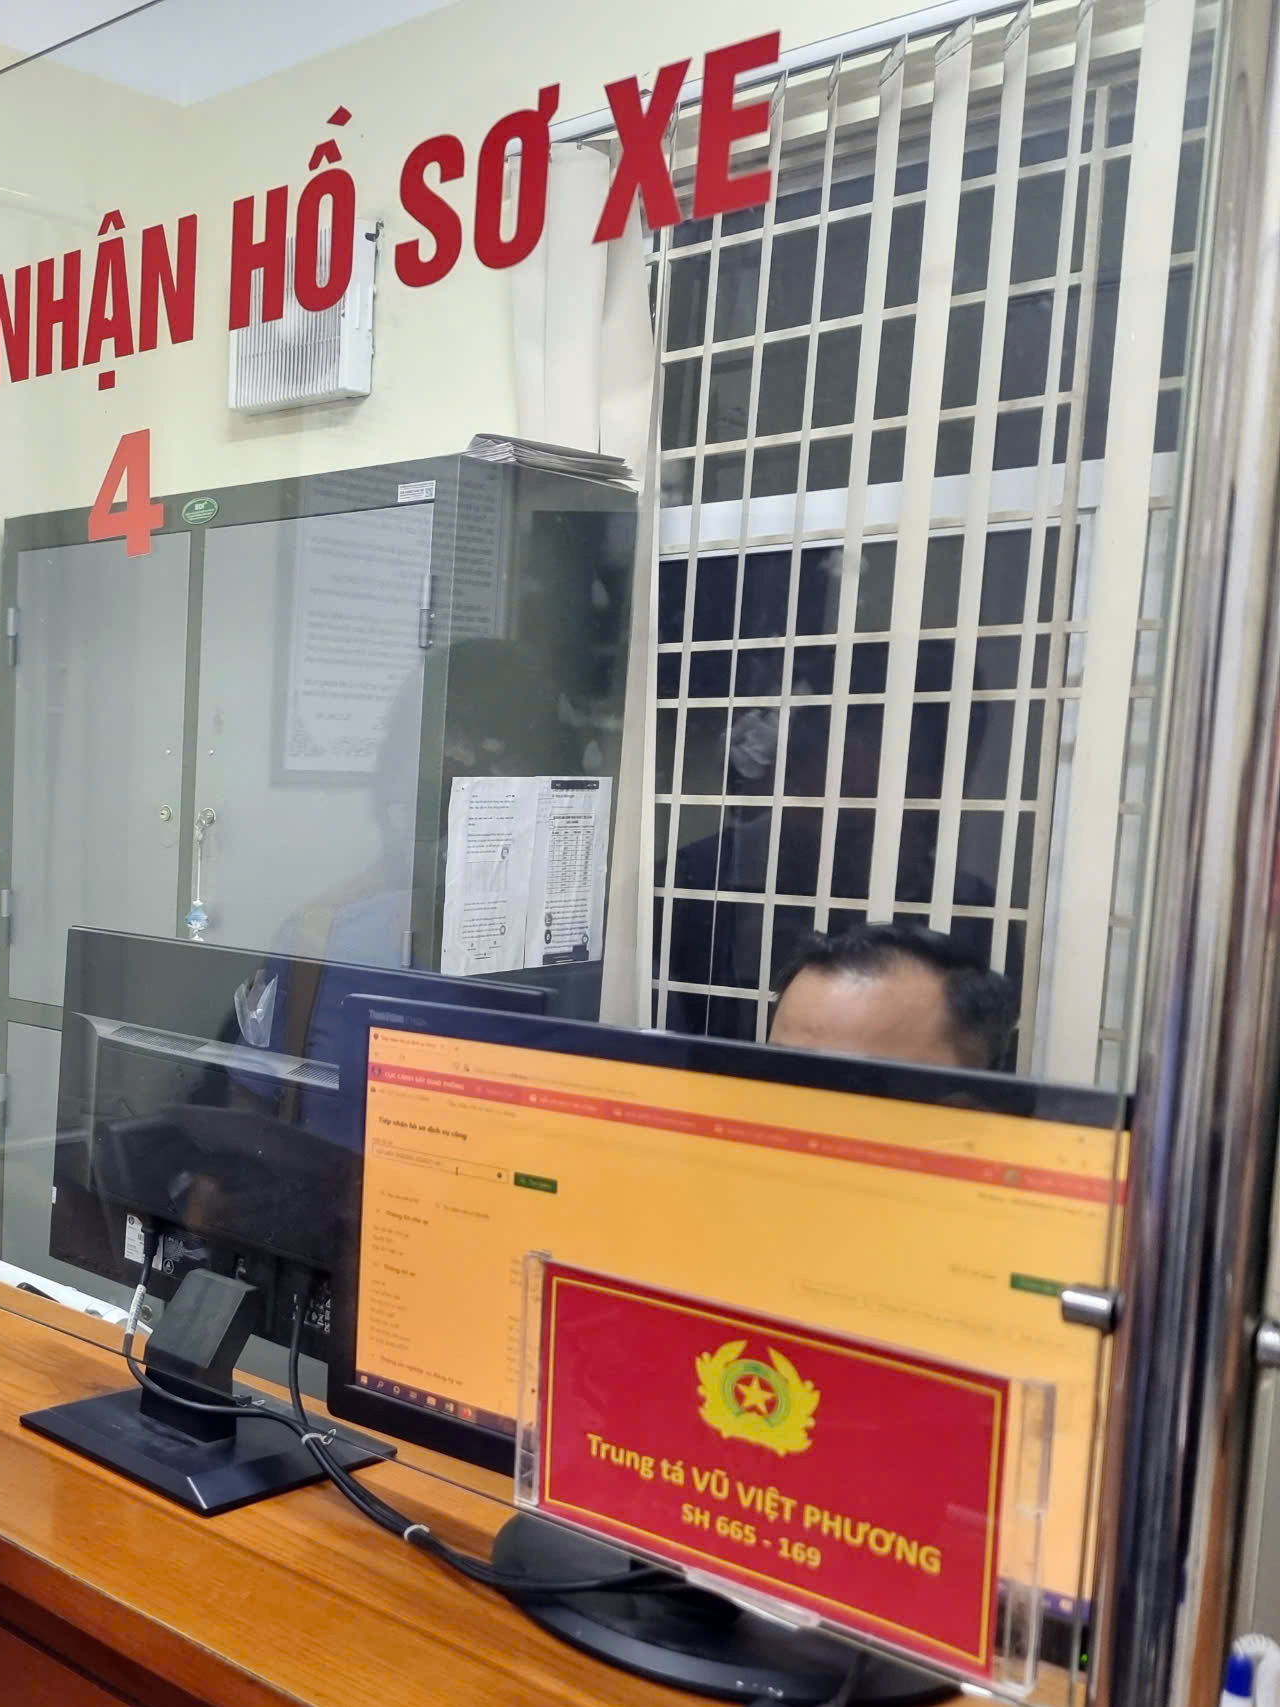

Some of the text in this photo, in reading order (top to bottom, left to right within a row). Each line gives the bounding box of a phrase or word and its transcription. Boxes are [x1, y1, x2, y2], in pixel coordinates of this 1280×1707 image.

[229, 107, 357, 330] HỒ
[395, 84, 561, 288] SƠ
[592, 31, 781, 244] XE
[89, 429, 163, 557] 4
[587, 1432, 943, 1576] Trung tá VŨ VIỆT PHƯƠNG
[681, 1503, 711, 1531] SH
[715, 1515, 758, 1546] 665
[778, 1536, 822, 1569] 169
